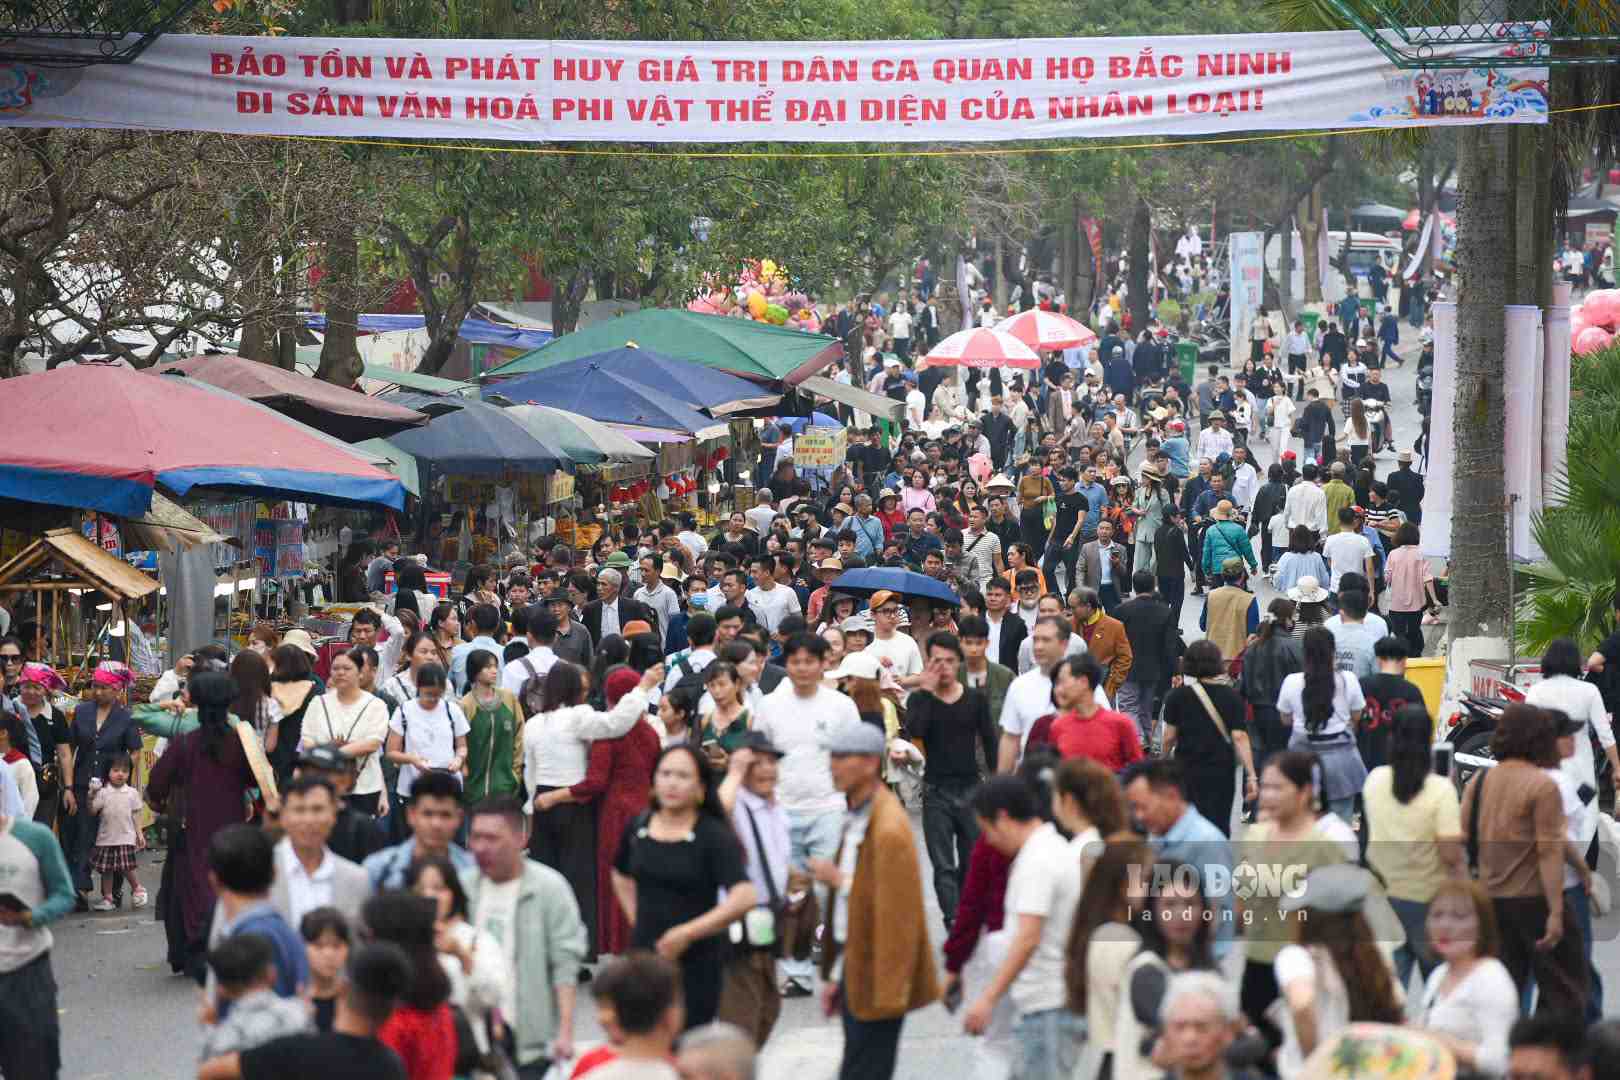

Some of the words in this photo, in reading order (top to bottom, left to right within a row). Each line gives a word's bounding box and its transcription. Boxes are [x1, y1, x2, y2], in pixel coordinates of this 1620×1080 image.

[211, 47, 286, 77] BẢO
[299, 48, 373, 80] TỒN
[385, 54, 433, 80] VÀ
[445, 53, 540, 81] PHÁT
[553, 57, 625, 82] HUY
[638, 55, 700, 82] GIÁ
[711, 59, 769, 88] TRỊ
[783, 56, 859, 82] DÂN
[871, 58, 919, 82] CA
[932, 57, 1032, 84] QUAN
[1046, 56, 1095, 84] HỌ
[1108, 47, 1185, 80] BẮC
[1198, 51, 1293, 78] NINH
[237, 91, 273, 115] DI
[287, 87, 364, 117] SẢN
[378, 92, 453, 119] VĂN
[466, 92, 540, 121] HOÁ
[552, 97, 614, 122] PHI
[626, 96, 695, 126] VẬT
[705, 90, 777, 122] THỂ
[785, 98, 847, 125] ĐẠI
[860, 96, 948, 127] DIỆN
[960, 90, 1036, 122] CỦA
[1048, 91, 1154, 119] NHÂN
[1167, 87, 1265, 118] LOẠI!
